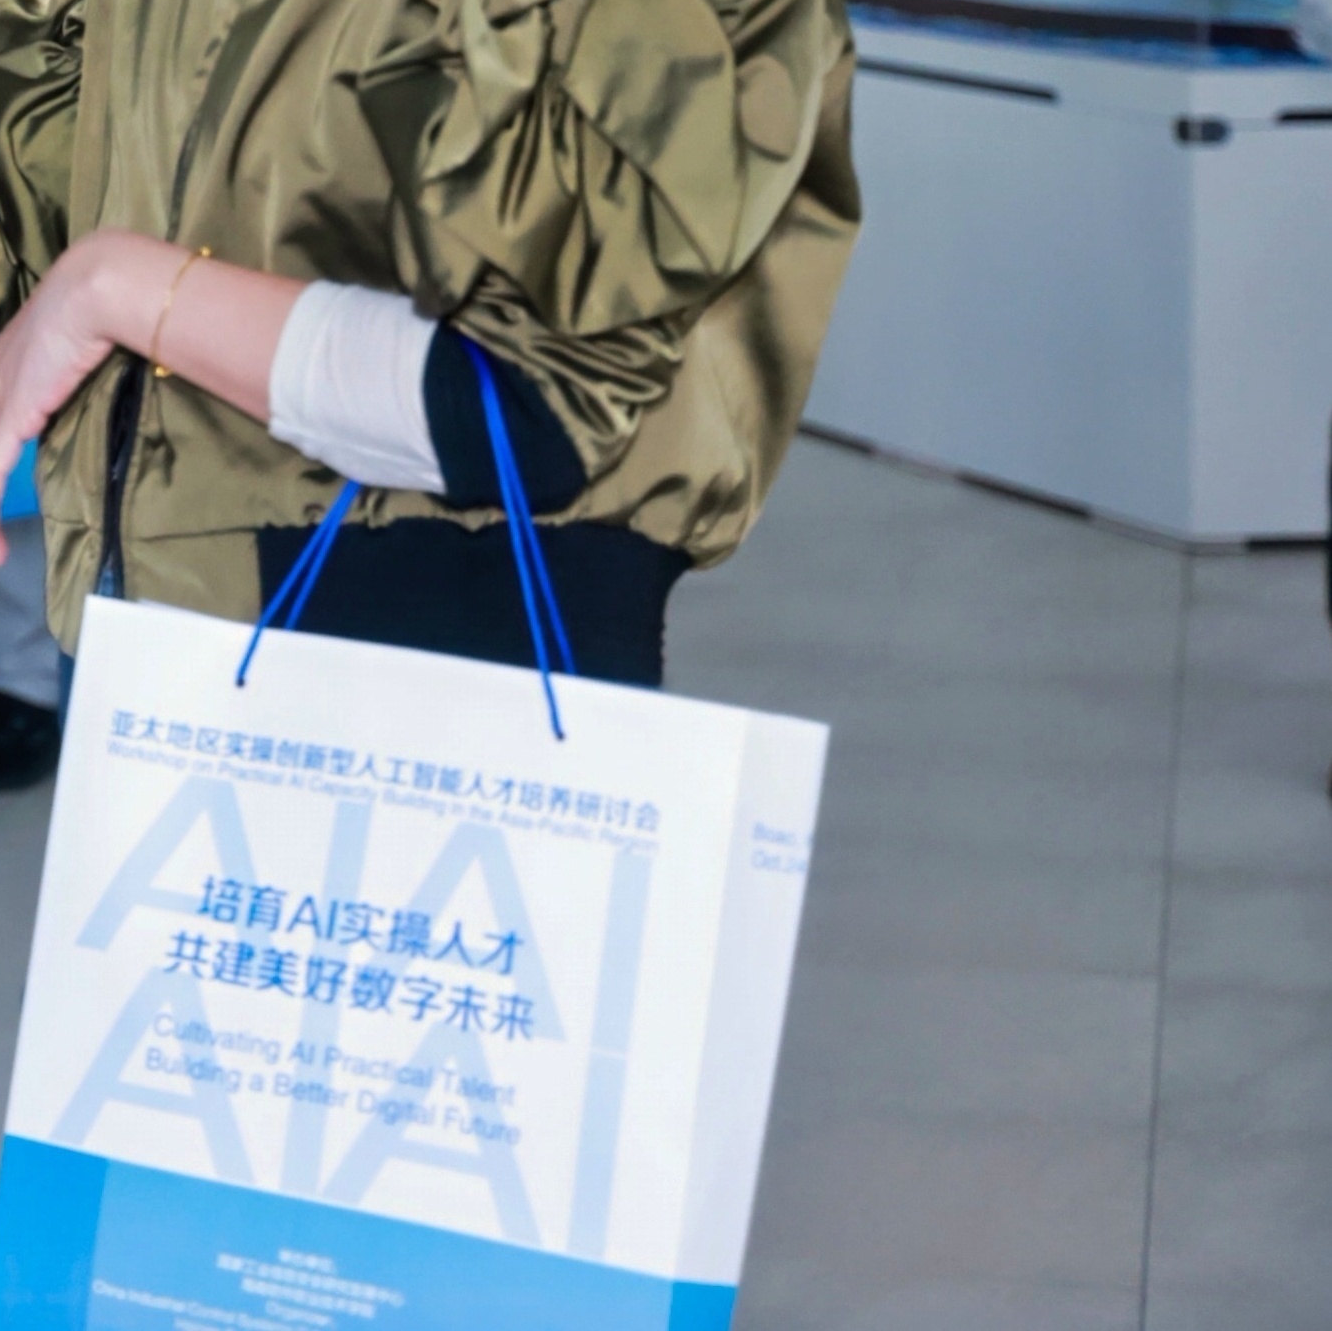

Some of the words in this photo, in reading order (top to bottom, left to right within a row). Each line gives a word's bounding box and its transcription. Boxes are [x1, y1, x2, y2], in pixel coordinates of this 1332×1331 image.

[197, 875, 525, 975] 培育AI实操人才
[162, 929, 535, 1041] 共建美好数字未来
[144, 1046, 241, 1093] Building
[248, 1075, 265, 1092] a
[272, 1073, 349, 1109] Better
[356, 1089, 436, 1126] Digital
[443, 1106, 522, 1145] Future
[151, 1012, 281, 1064] Cultivating
[290, 1042, 316, 1065] AI
[323, 1046, 435, 1088] Practical
[441, 1066, 517, 1106] Talent
